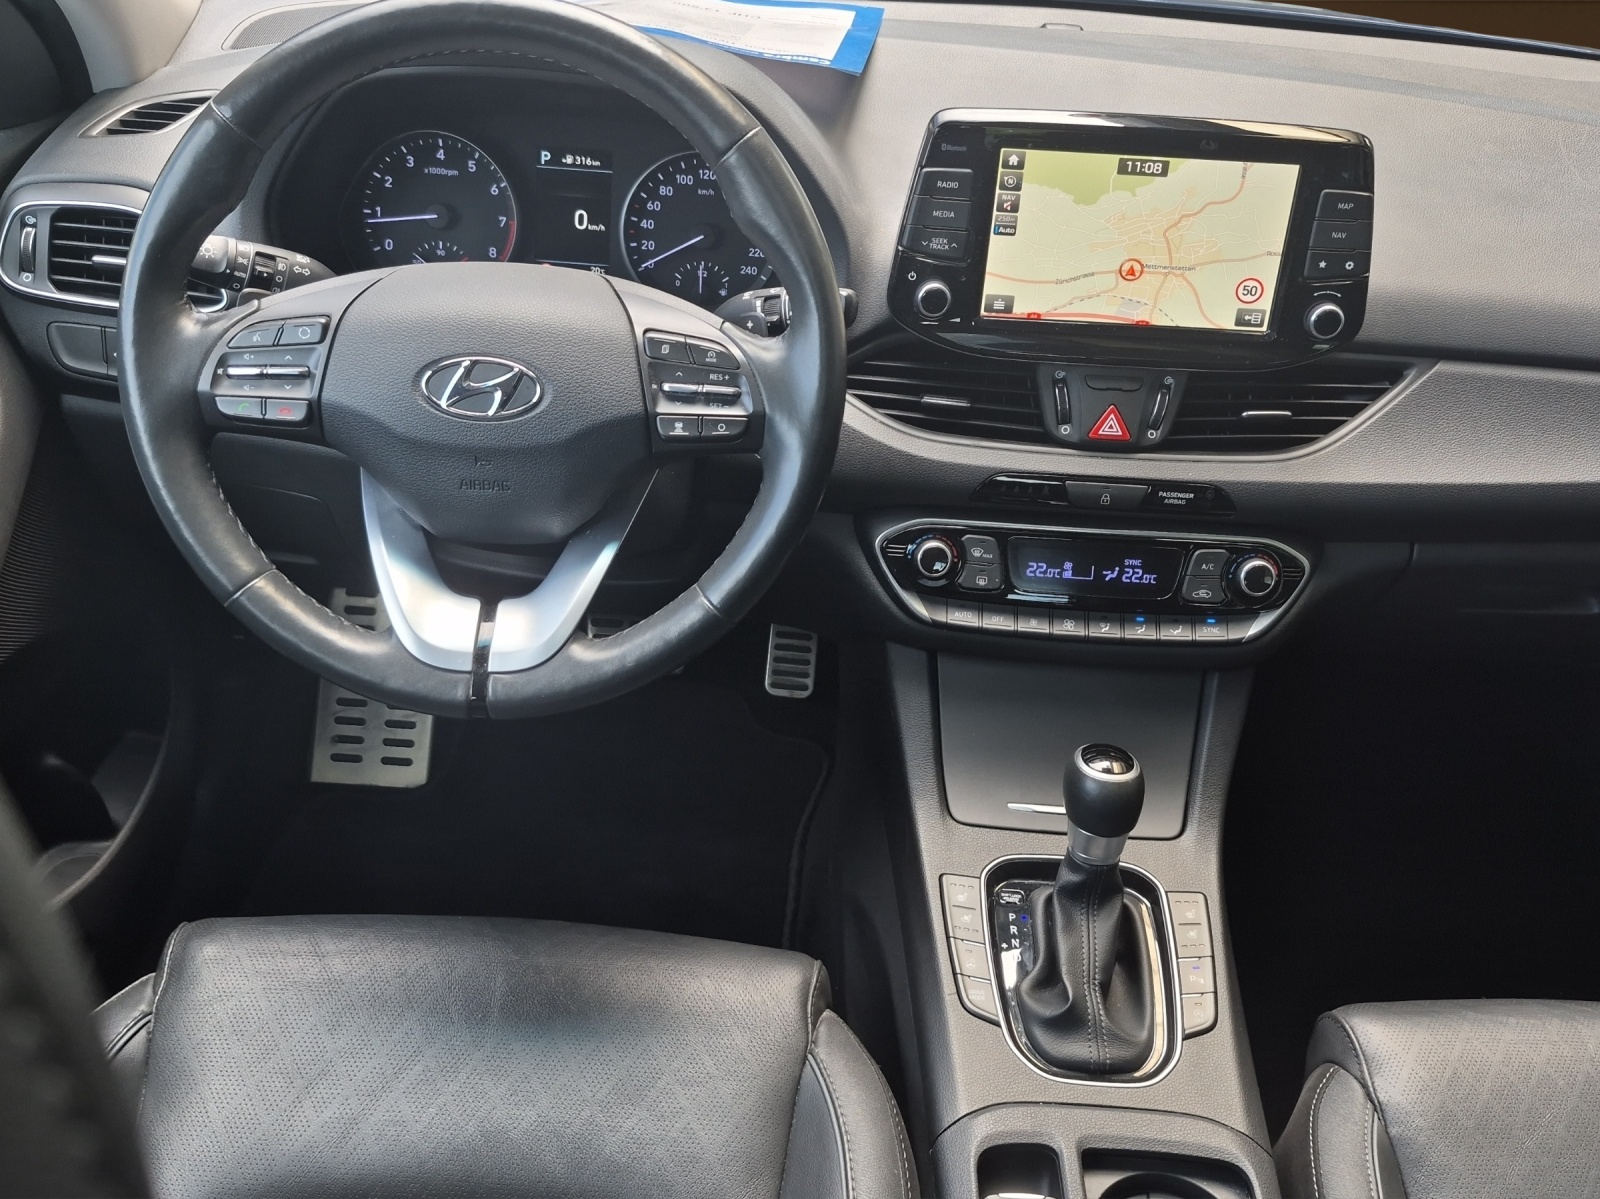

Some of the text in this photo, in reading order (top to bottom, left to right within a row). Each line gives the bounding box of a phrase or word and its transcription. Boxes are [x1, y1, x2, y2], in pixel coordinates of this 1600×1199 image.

[436, 149, 445, 160] 4
[541, 150, 551, 165] P
[406, 155, 414, 167] 3
[468, 160, 476, 172] 5
[424, 167, 459, 177] x1000rpm
[1126, 161, 1163, 174] 11:08
[384, 176, 393, 188] 2
[675, 174, 694, 185] 100
[936, 180, 959, 189] RADIO
[490, 184, 499, 195] 6
[659, 185, 673, 196] 80
[698, 188, 715, 196] km/h
[646, 200, 661, 211] 60
[1337, 202, 1354, 210] MAP
[375, 206, 381, 217] 1
[932, 210, 955, 218] MEDIA
[498, 216, 507, 227] 7
[640, 219, 655, 230] 40
[998, 226, 1015, 234] Auto
[1331, 231, 1347, 239] NAV
[385, 239, 394, 250] 0
[641, 240, 655, 251] 20
[929, 243, 950, 251] TRACK
[488, 247, 497, 258] 8
[740, 265, 758, 275] 240
[1241, 284, 1258, 297] 50
[460, 479, 511, 492] AIRBAG
[1158, 491, 1195, 499] PASSENGER
[1124, 558, 1143, 566] SYNC
[1201, 563, 1215, 571] A/C
[1008, 913, 1016, 922] P
[1009, 925, 1018, 935] R
[1011, 938, 1020, 948] N
